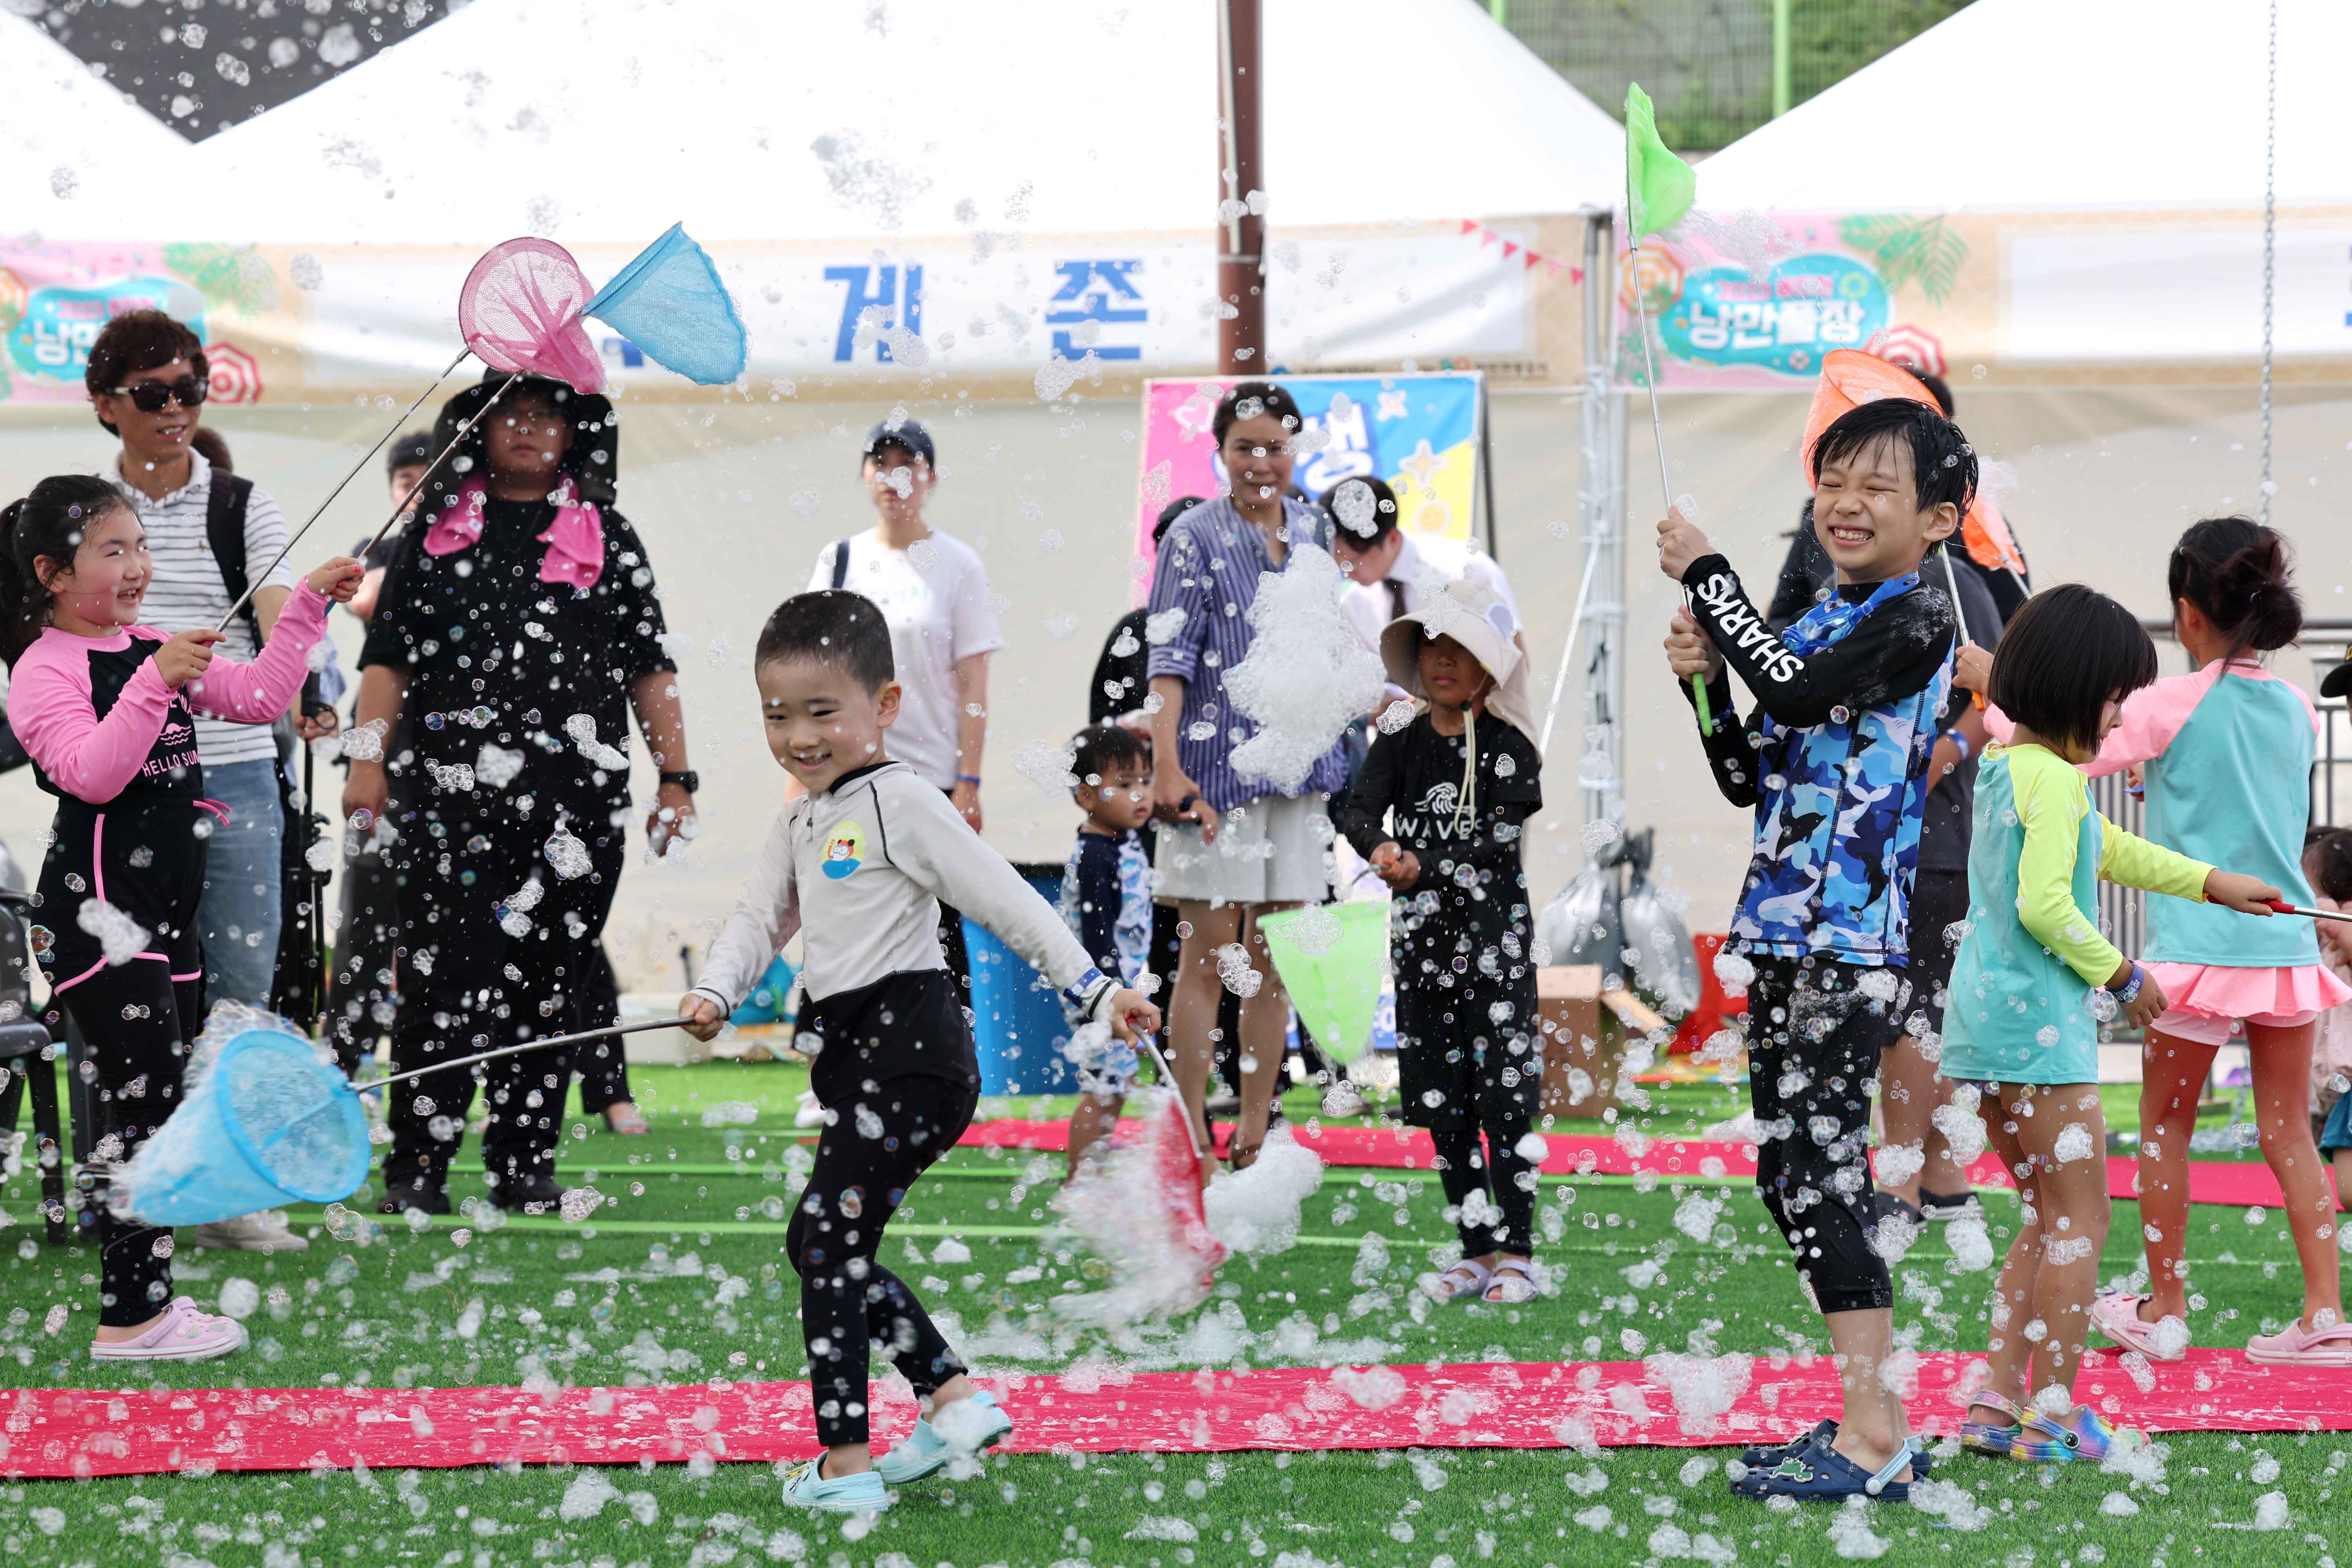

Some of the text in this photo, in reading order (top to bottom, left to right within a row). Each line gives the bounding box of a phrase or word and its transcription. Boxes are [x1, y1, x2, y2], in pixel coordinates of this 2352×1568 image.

[824, 260, 1147, 363] 게 존
[1697, 573, 1805, 682] SHARKS
[142, 753, 181, 777] HELLO
